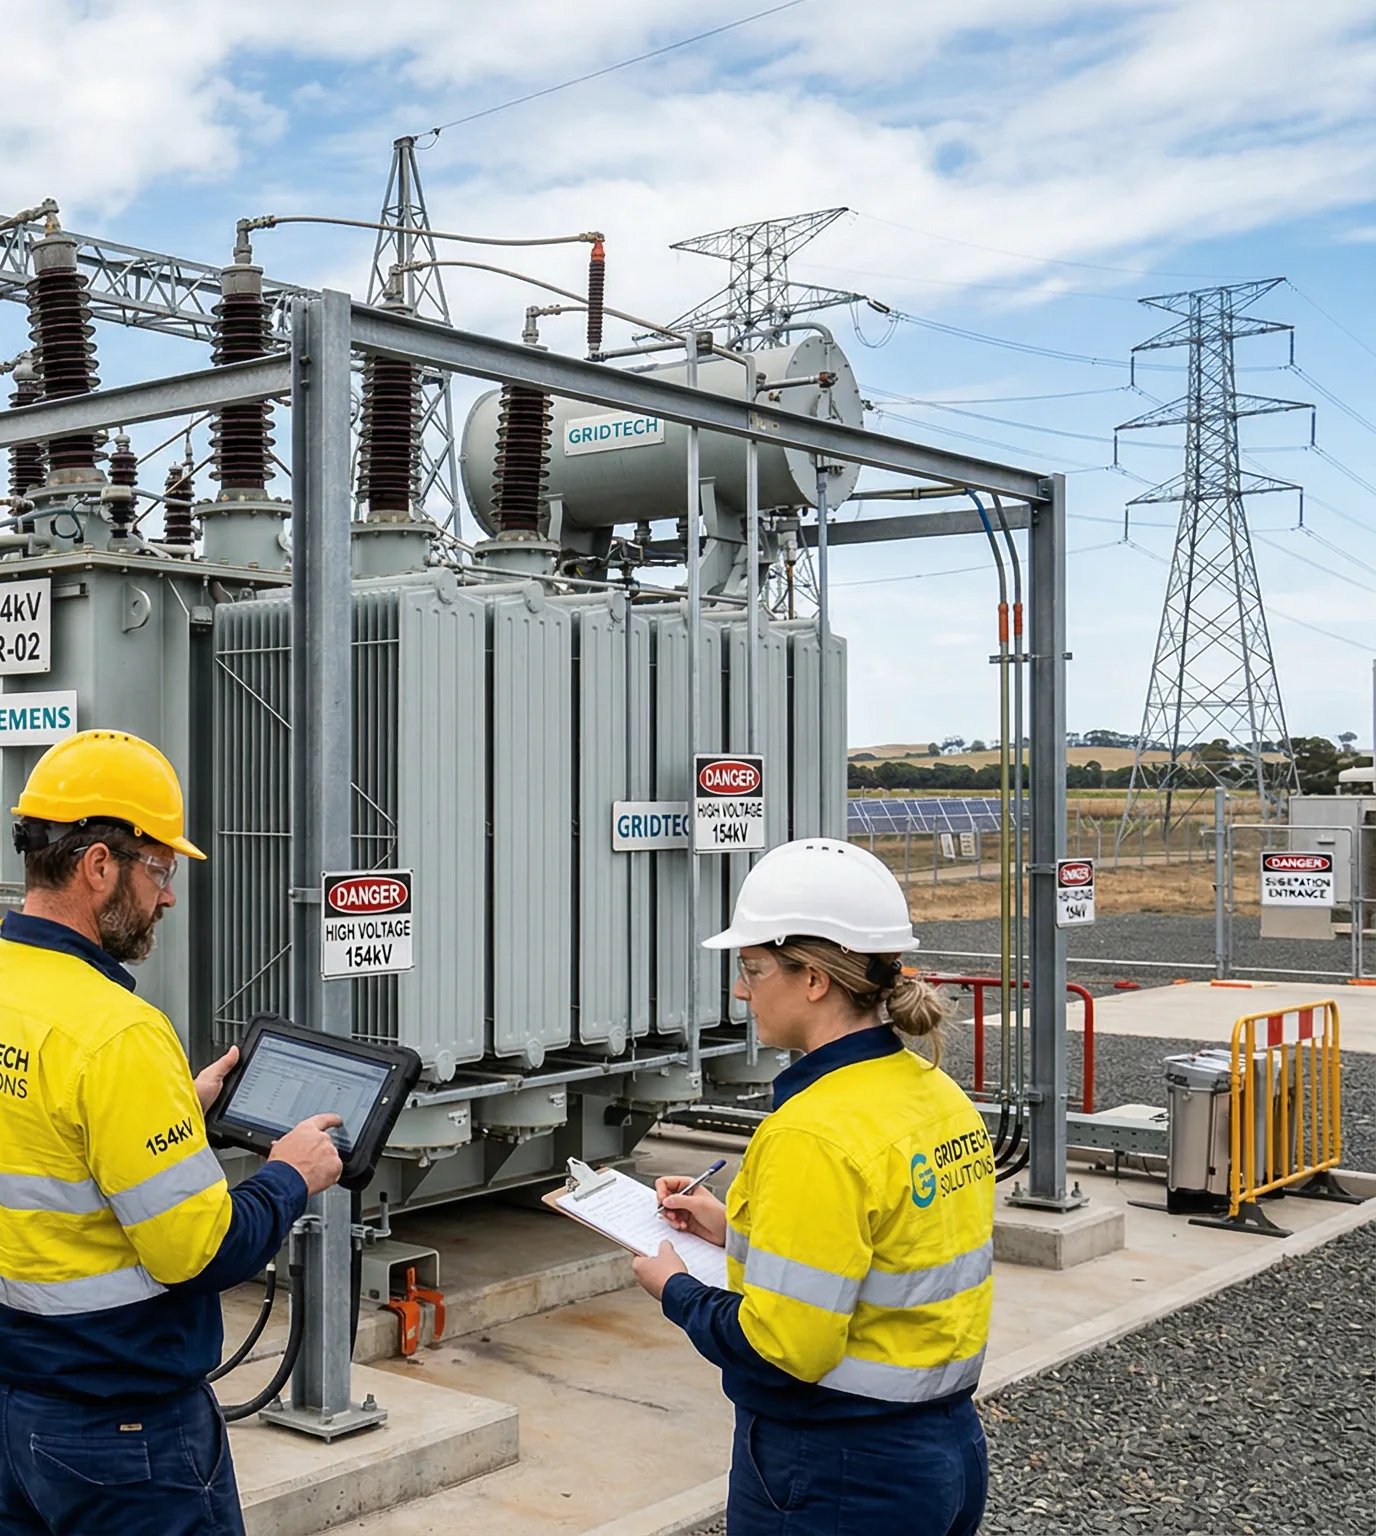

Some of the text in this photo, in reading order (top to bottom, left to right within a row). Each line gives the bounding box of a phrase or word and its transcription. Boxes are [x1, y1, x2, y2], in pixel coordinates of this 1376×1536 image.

[569, 418, 658, 444] GRIDTECH
[705, 769, 755, 786] DANGER
[617, 814, 689, 838] GRIDTEC
[712, 822, 748, 843] 154kV
[337, 884, 401, 907] DANGER
[326, 920, 411, 941] HIGH VOLTAGE
[345, 944, 392, 967] 154kV
[146, 1117, 193, 1156] 154kV
